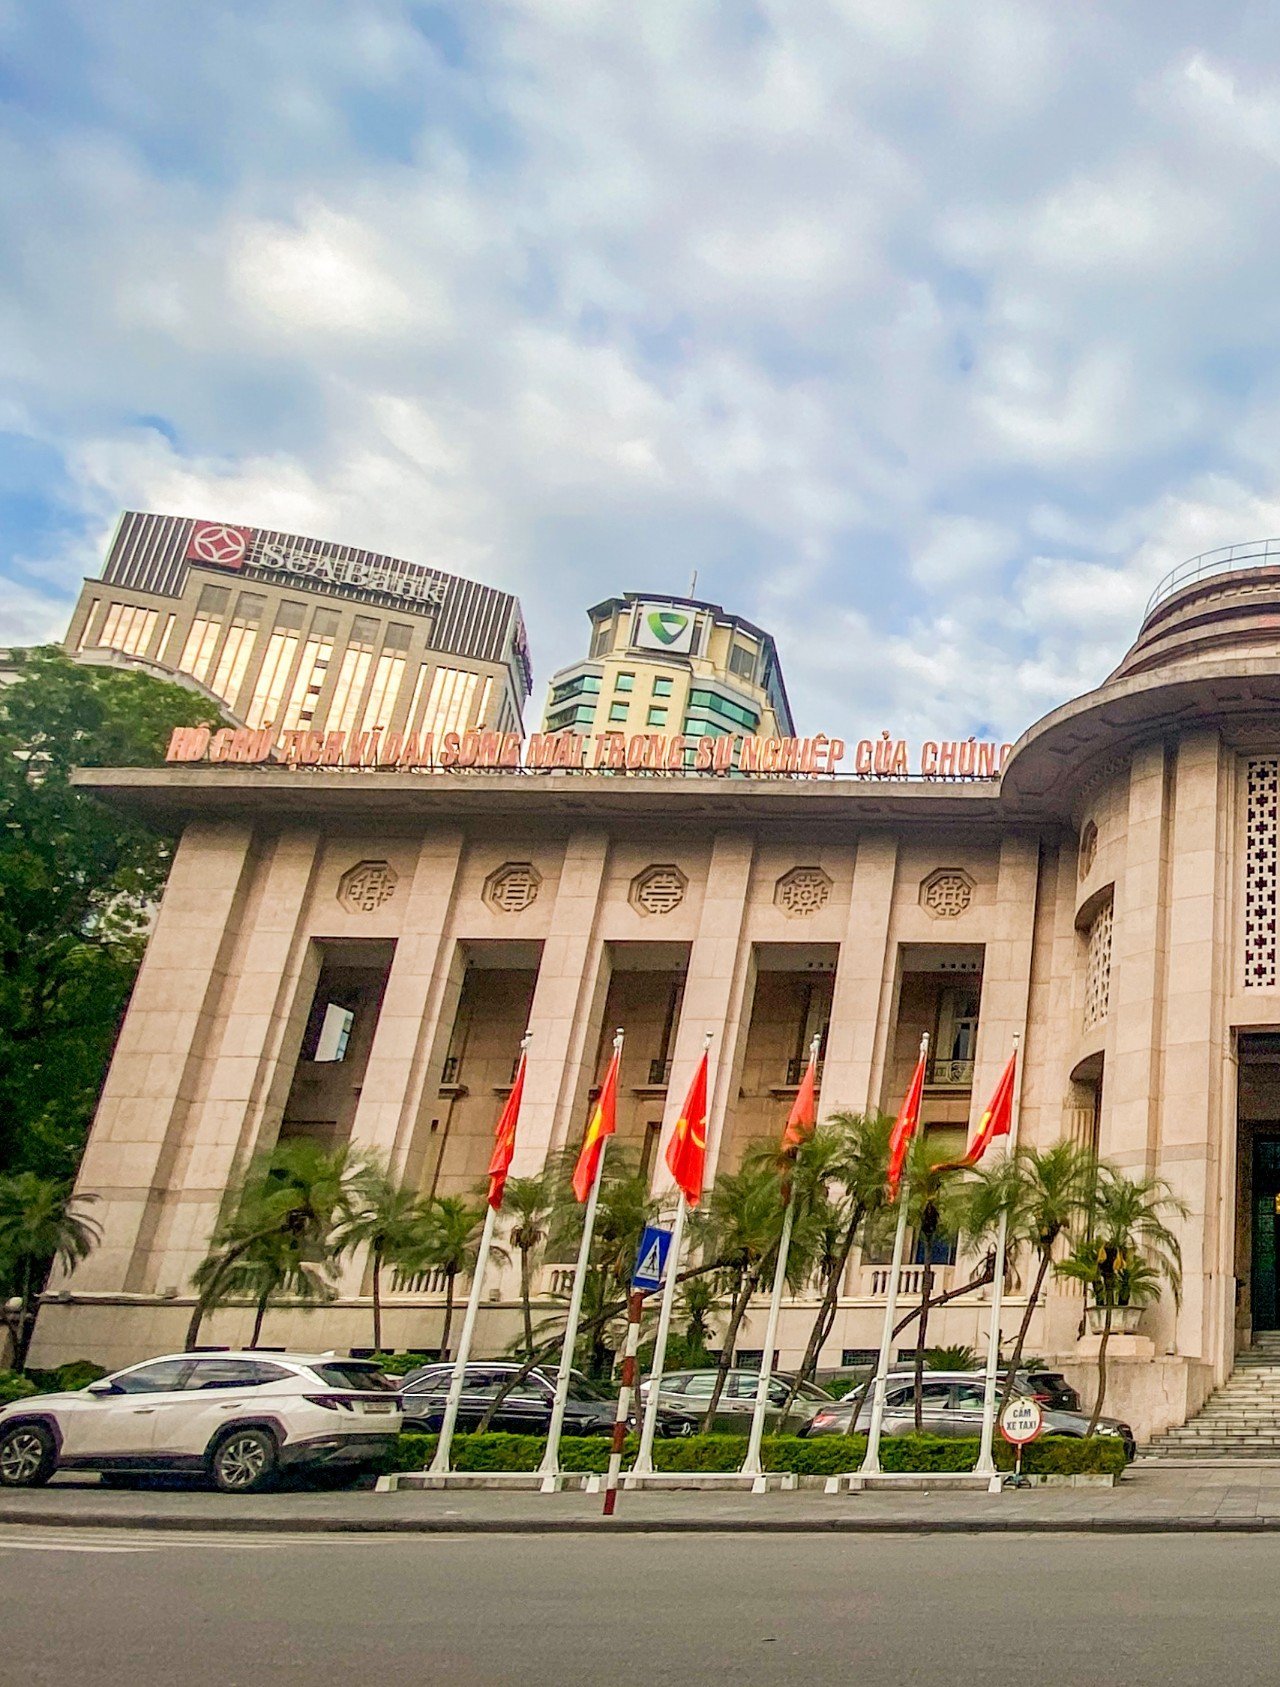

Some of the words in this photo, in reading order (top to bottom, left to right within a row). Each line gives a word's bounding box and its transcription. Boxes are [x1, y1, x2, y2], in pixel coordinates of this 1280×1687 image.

[593, 732, 686, 770] TRONG
[856, 730, 909, 776] CỦA
[1006, 1422, 1016, 1430] XE
[1019, 1421, 1036, 1430] TAXI
